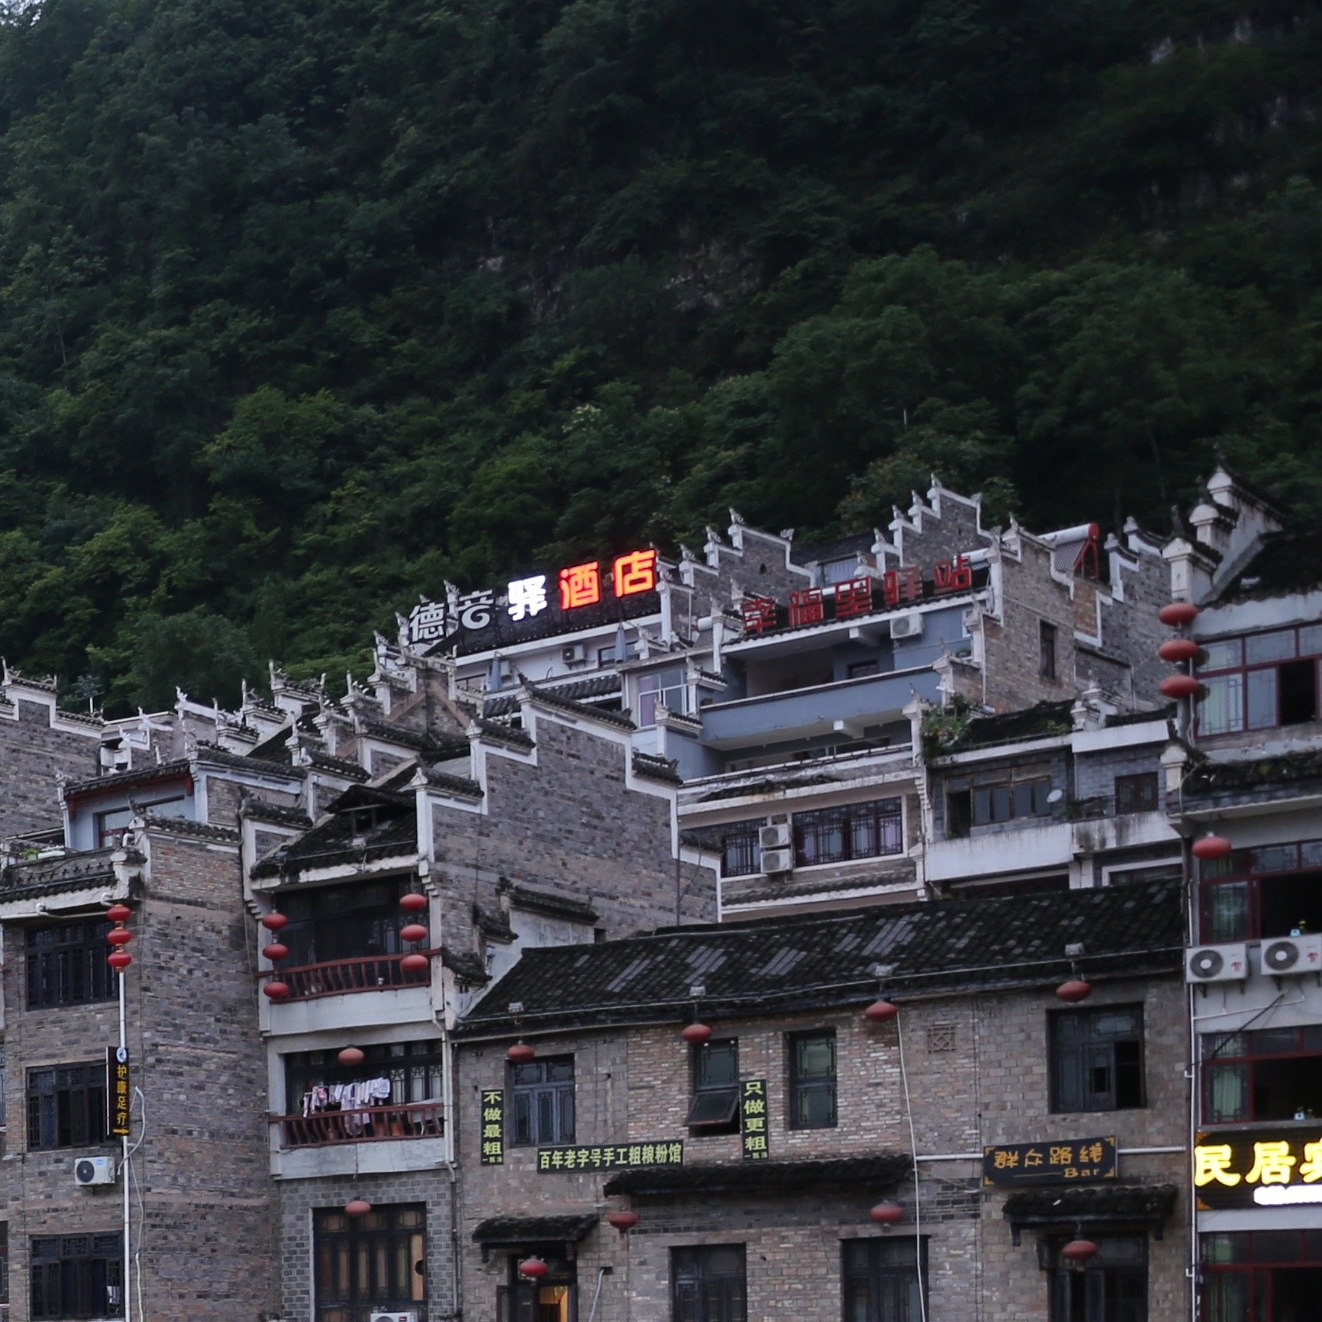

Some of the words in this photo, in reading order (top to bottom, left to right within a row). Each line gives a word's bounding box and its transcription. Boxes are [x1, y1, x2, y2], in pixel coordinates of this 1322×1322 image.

[483, 1091, 502, 1155] 不做最粗
[744, 1081, 767, 1151] 只做更粗
[539, 1142, 682, 1170] 百年老字号手工粗粮粉馆
[993, 1142, 1103, 1170] 群众路线
[1064, 1166, 1101, 1179] Bar
